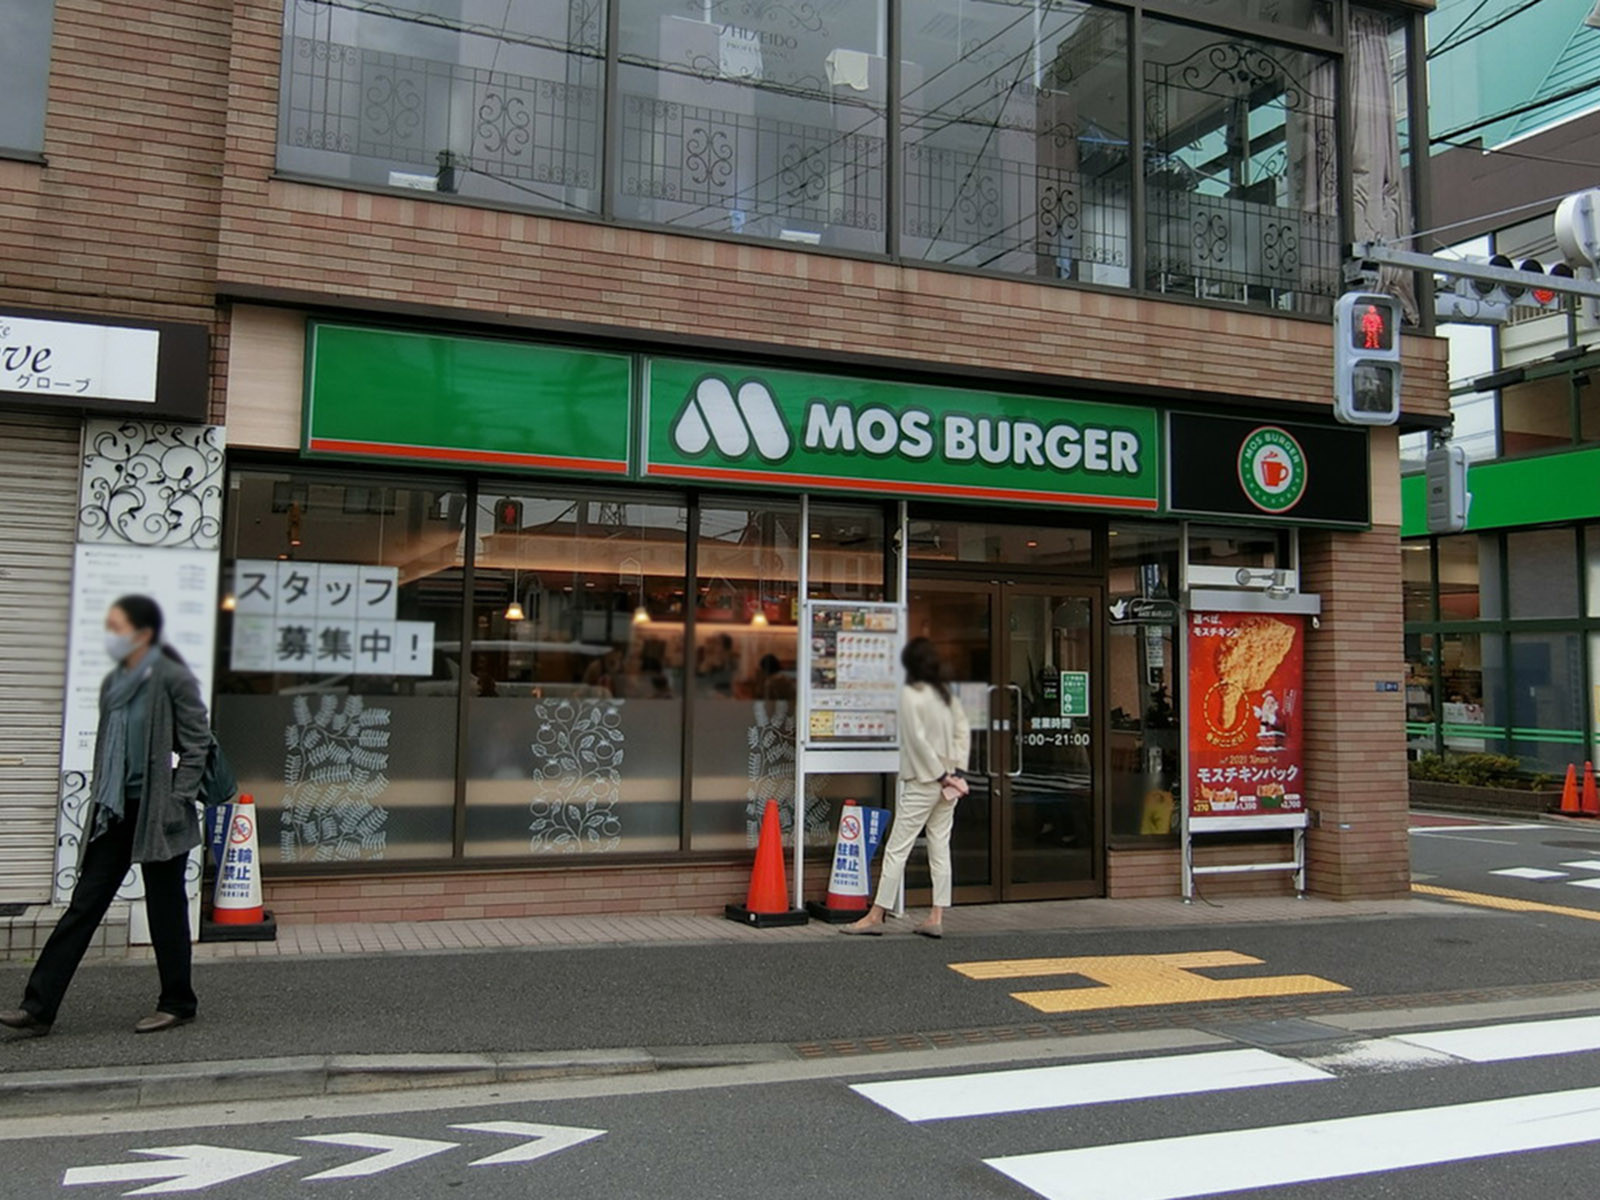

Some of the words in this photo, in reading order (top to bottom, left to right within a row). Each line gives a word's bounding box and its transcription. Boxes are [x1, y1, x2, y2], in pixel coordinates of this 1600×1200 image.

[805, 403, 933, 457] MOS
[945, 416, 1139, 473] BURGER
[1244, 436, 1263, 460] MOS
[1264, 433, 1300, 463] BURGER
[238, 571, 393, 606] スタッフ
[1196, 764, 1298, 783] モスチキンパック
[223, 865, 251, 881] 禁止
[836, 857, 859, 872] 禁止
